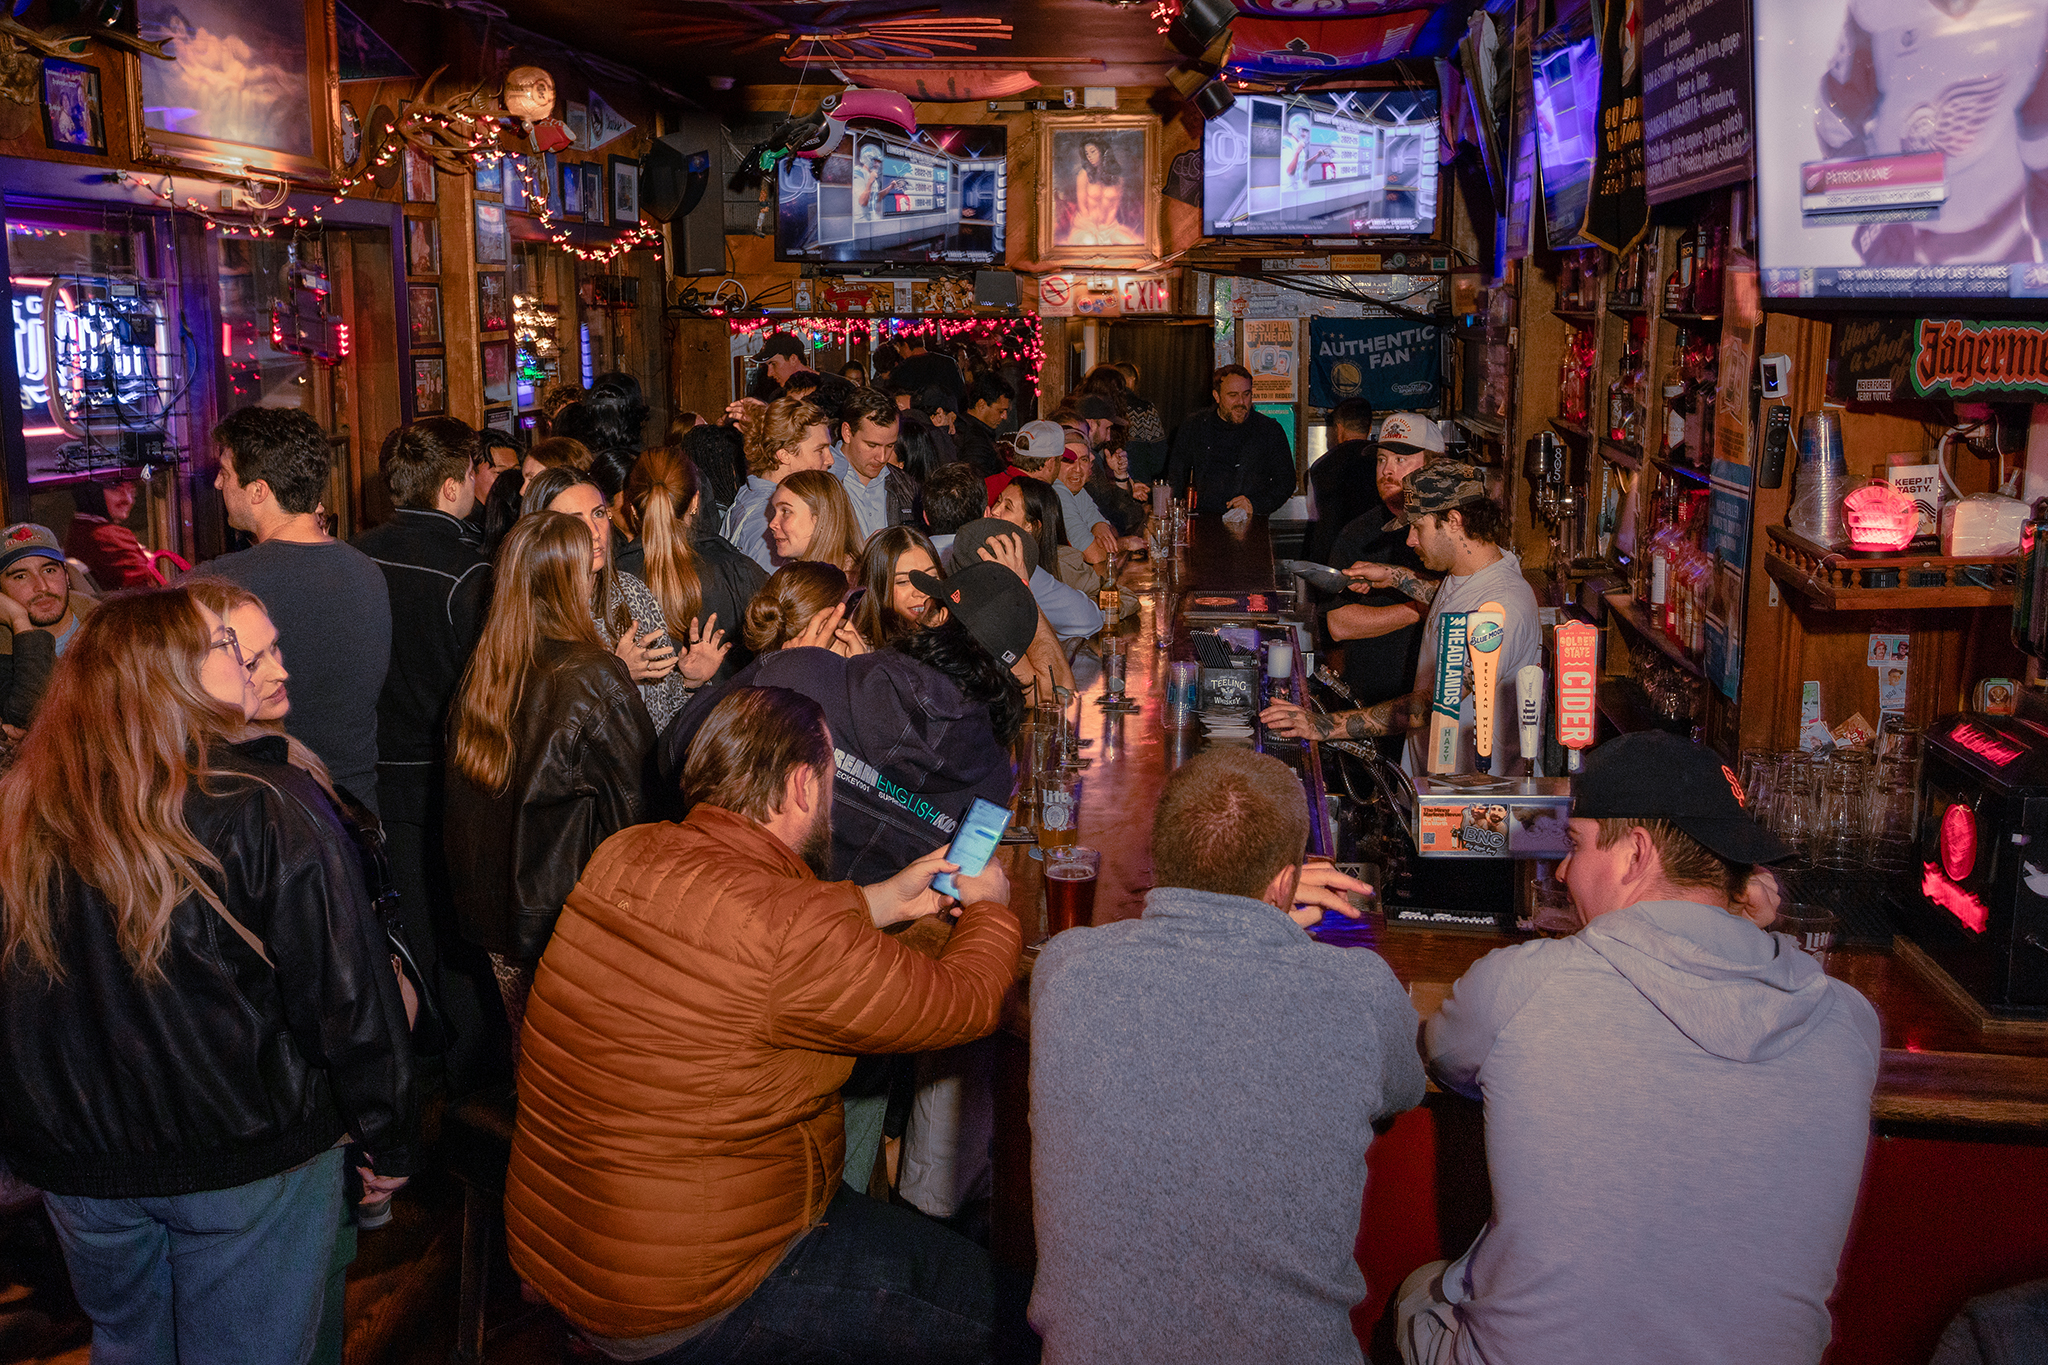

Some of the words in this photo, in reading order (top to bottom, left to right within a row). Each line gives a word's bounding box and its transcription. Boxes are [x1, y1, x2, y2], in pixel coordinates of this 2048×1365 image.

[1669, 27, 1691, 55] lemonade
[1720, 32, 1740, 57] ginger
[1677, 81, 1690, 100] beer
[1696, 70, 1709, 90] lime
[1721, 108, 1743, 140] splash
[936, 172, 945, 181] 15
[1825, 167, 1863, 185] PATRICK
[1863, 164, 1895, 181] KANE
[936, 185, 945, 194] 15
[936, 198, 945, 207] 15
[1881, 266, 1918, 280] STRAIGHT
[1977, 266, 2009, 279] GAMES
[1124, 278, 1164, 311] EXIT
[1247, 321, 1271, 332] BEST
[1272, 321, 1293, 332] PLAY
[1247, 332, 1258, 342] OF
[1259, 332, 1277, 342] THE
[1277, 332, 1294, 342] DAY
[1319, 325, 1436, 357] AUTHENTIC
[1840, 321, 1880, 357] Have
[1864, 329, 1912, 370] shot
[1369, 348, 1411, 370] FAN
[1857, 381, 1873, 389] NEVER
[1874, 381, 1891, 389] FORGET
[1857, 392, 1872, 401] JERRY
[1873, 391, 1891, 401] TUTTLE
[1553, 447, 1562, 480] 805
[1894, 477, 1922, 487] KEEP
[1924, 476, 1935, 485] IT
[1897, 485, 1932, 494] TASTY.
[1470, 633, 1487, 646] BLUE
[1488, 627, 1504, 640] MOON
[1559, 635, 1595, 648] GOLDEN
[1564, 647, 1591, 658] STATE
[1443, 628, 1466, 705] HEADLANDS
[1211, 679, 1247, 691] TEELING
[1214, 697, 1241, 705] WHISKEY
[1561, 671, 1592, 741] CIDER
[1443, 729, 1451, 762] HAZY
[833, 748, 880, 787] REAM
[876, 774, 941, 824] ENGLISH
[835, 769, 871, 793] ECKEY001
[1463, 826, 1504, 847] BNG
